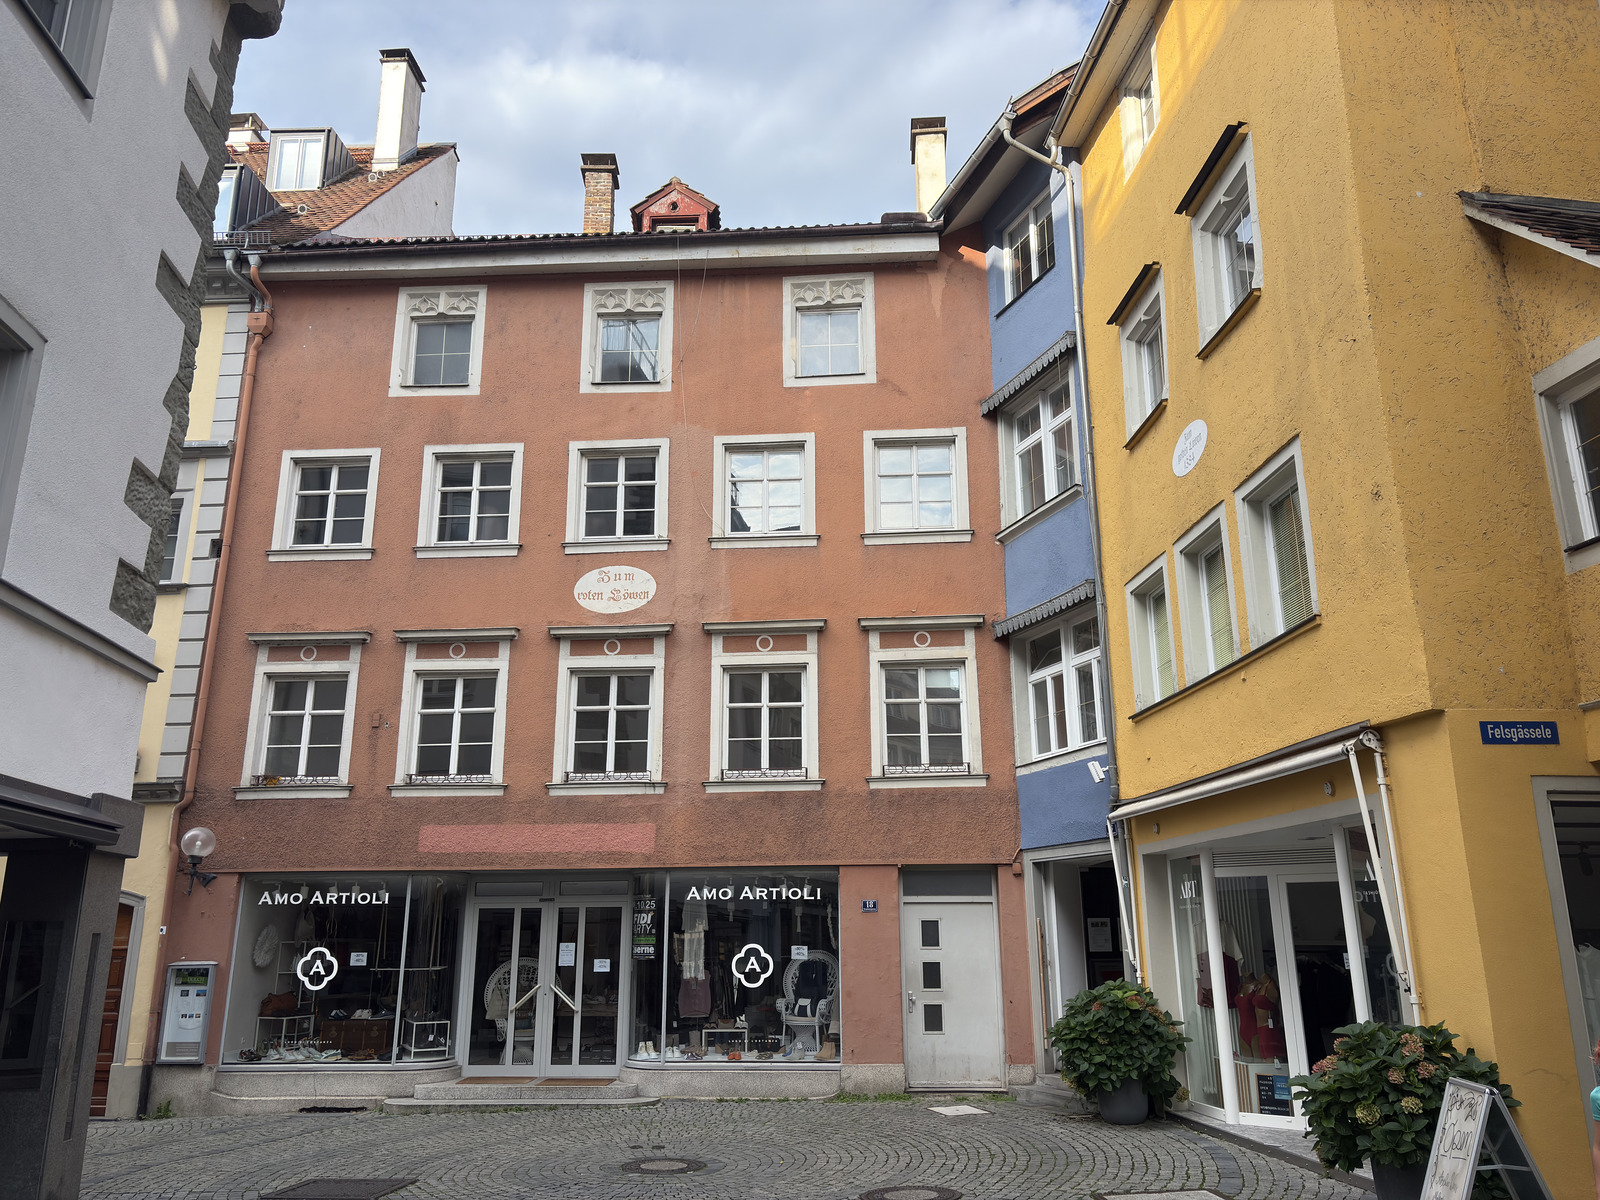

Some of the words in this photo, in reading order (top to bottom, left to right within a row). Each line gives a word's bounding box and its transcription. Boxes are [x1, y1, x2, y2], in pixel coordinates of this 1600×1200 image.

[597, 570, 635, 583] Zum
[577, 590, 604, 601] roten
[607, 588, 650, 602] Löwen
[1487, 724, 1552, 742] Felsgässele
[309, 959, 326, 976] A
[744, 956, 762, 973] A
